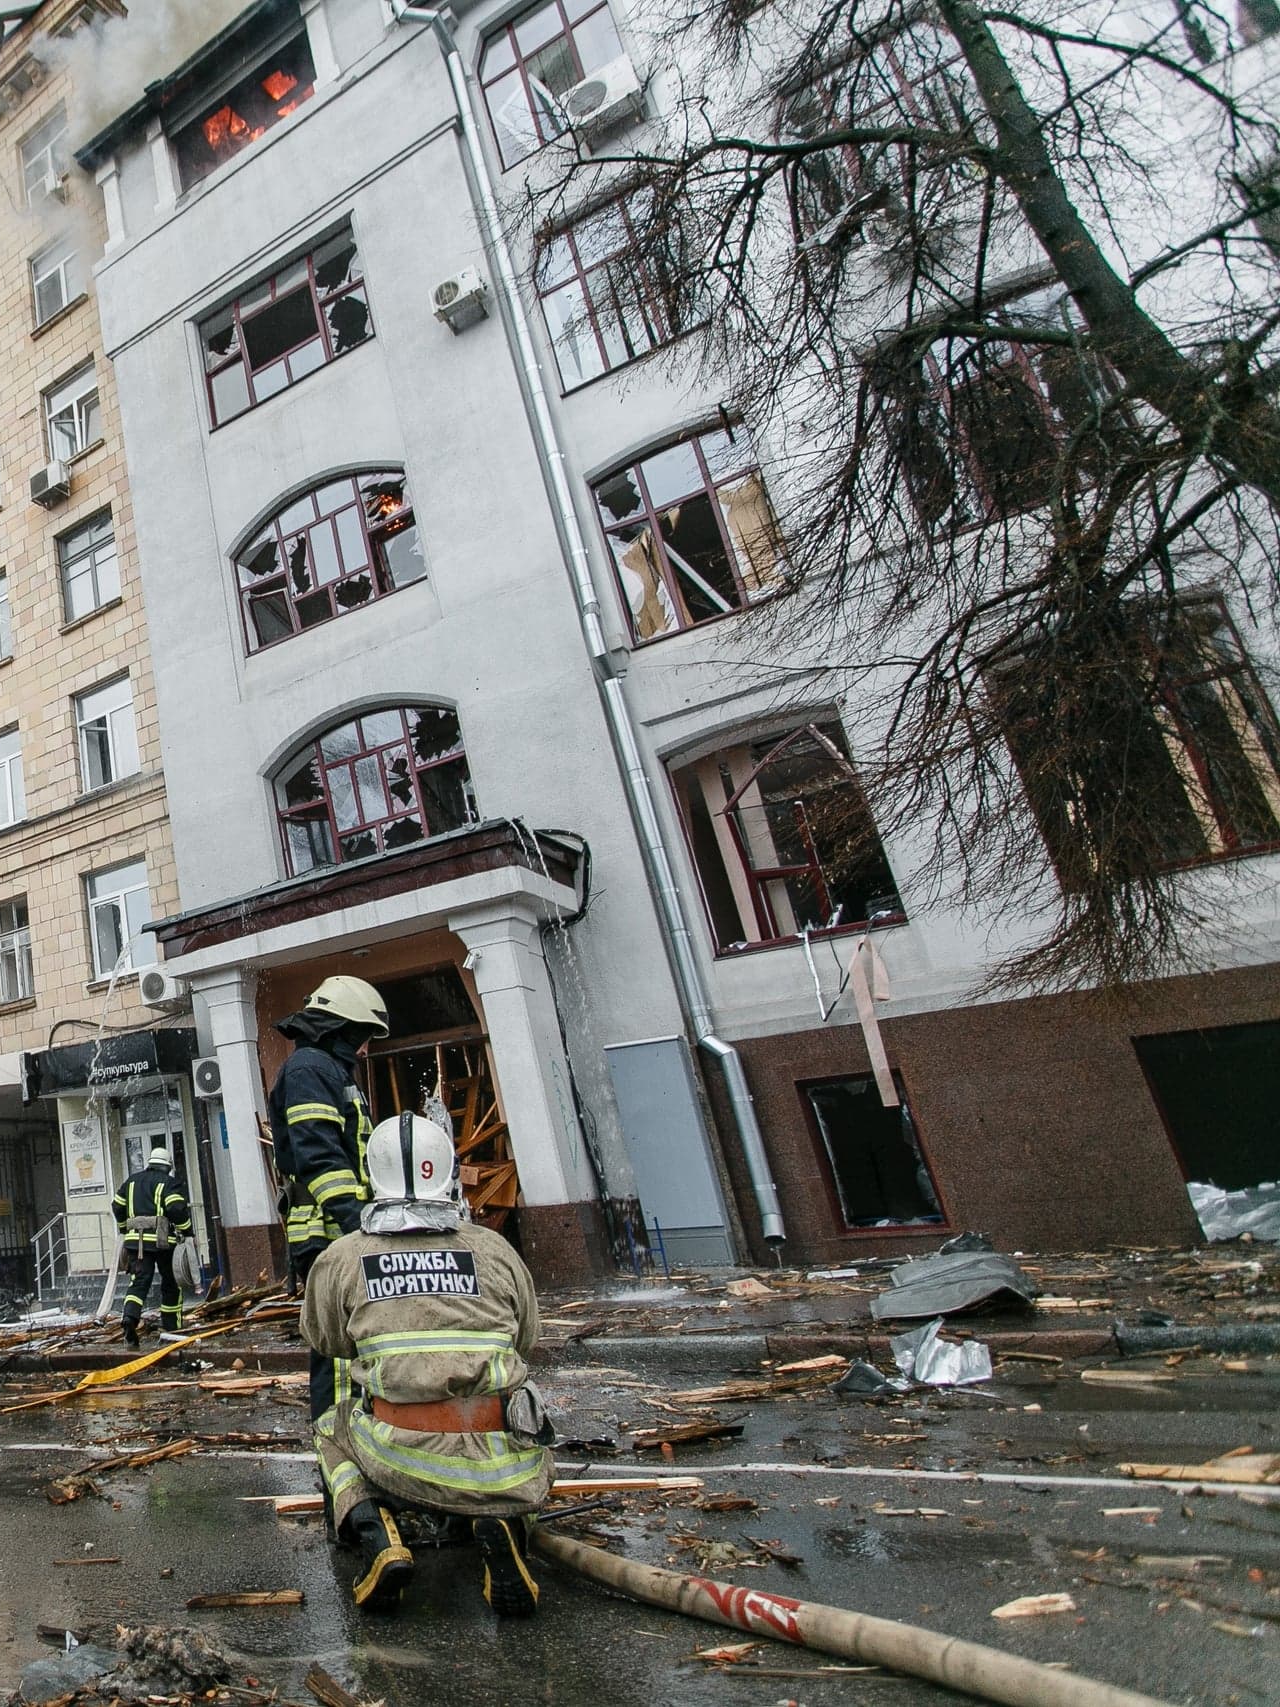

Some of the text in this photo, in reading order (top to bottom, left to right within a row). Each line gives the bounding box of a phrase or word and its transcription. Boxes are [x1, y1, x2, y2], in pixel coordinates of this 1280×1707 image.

[421, 1160, 434, 1180] 9
[378, 1252, 459, 1273] СЛУЖБА
[368, 1273, 475, 1298] ПОРЯТУНКУ
